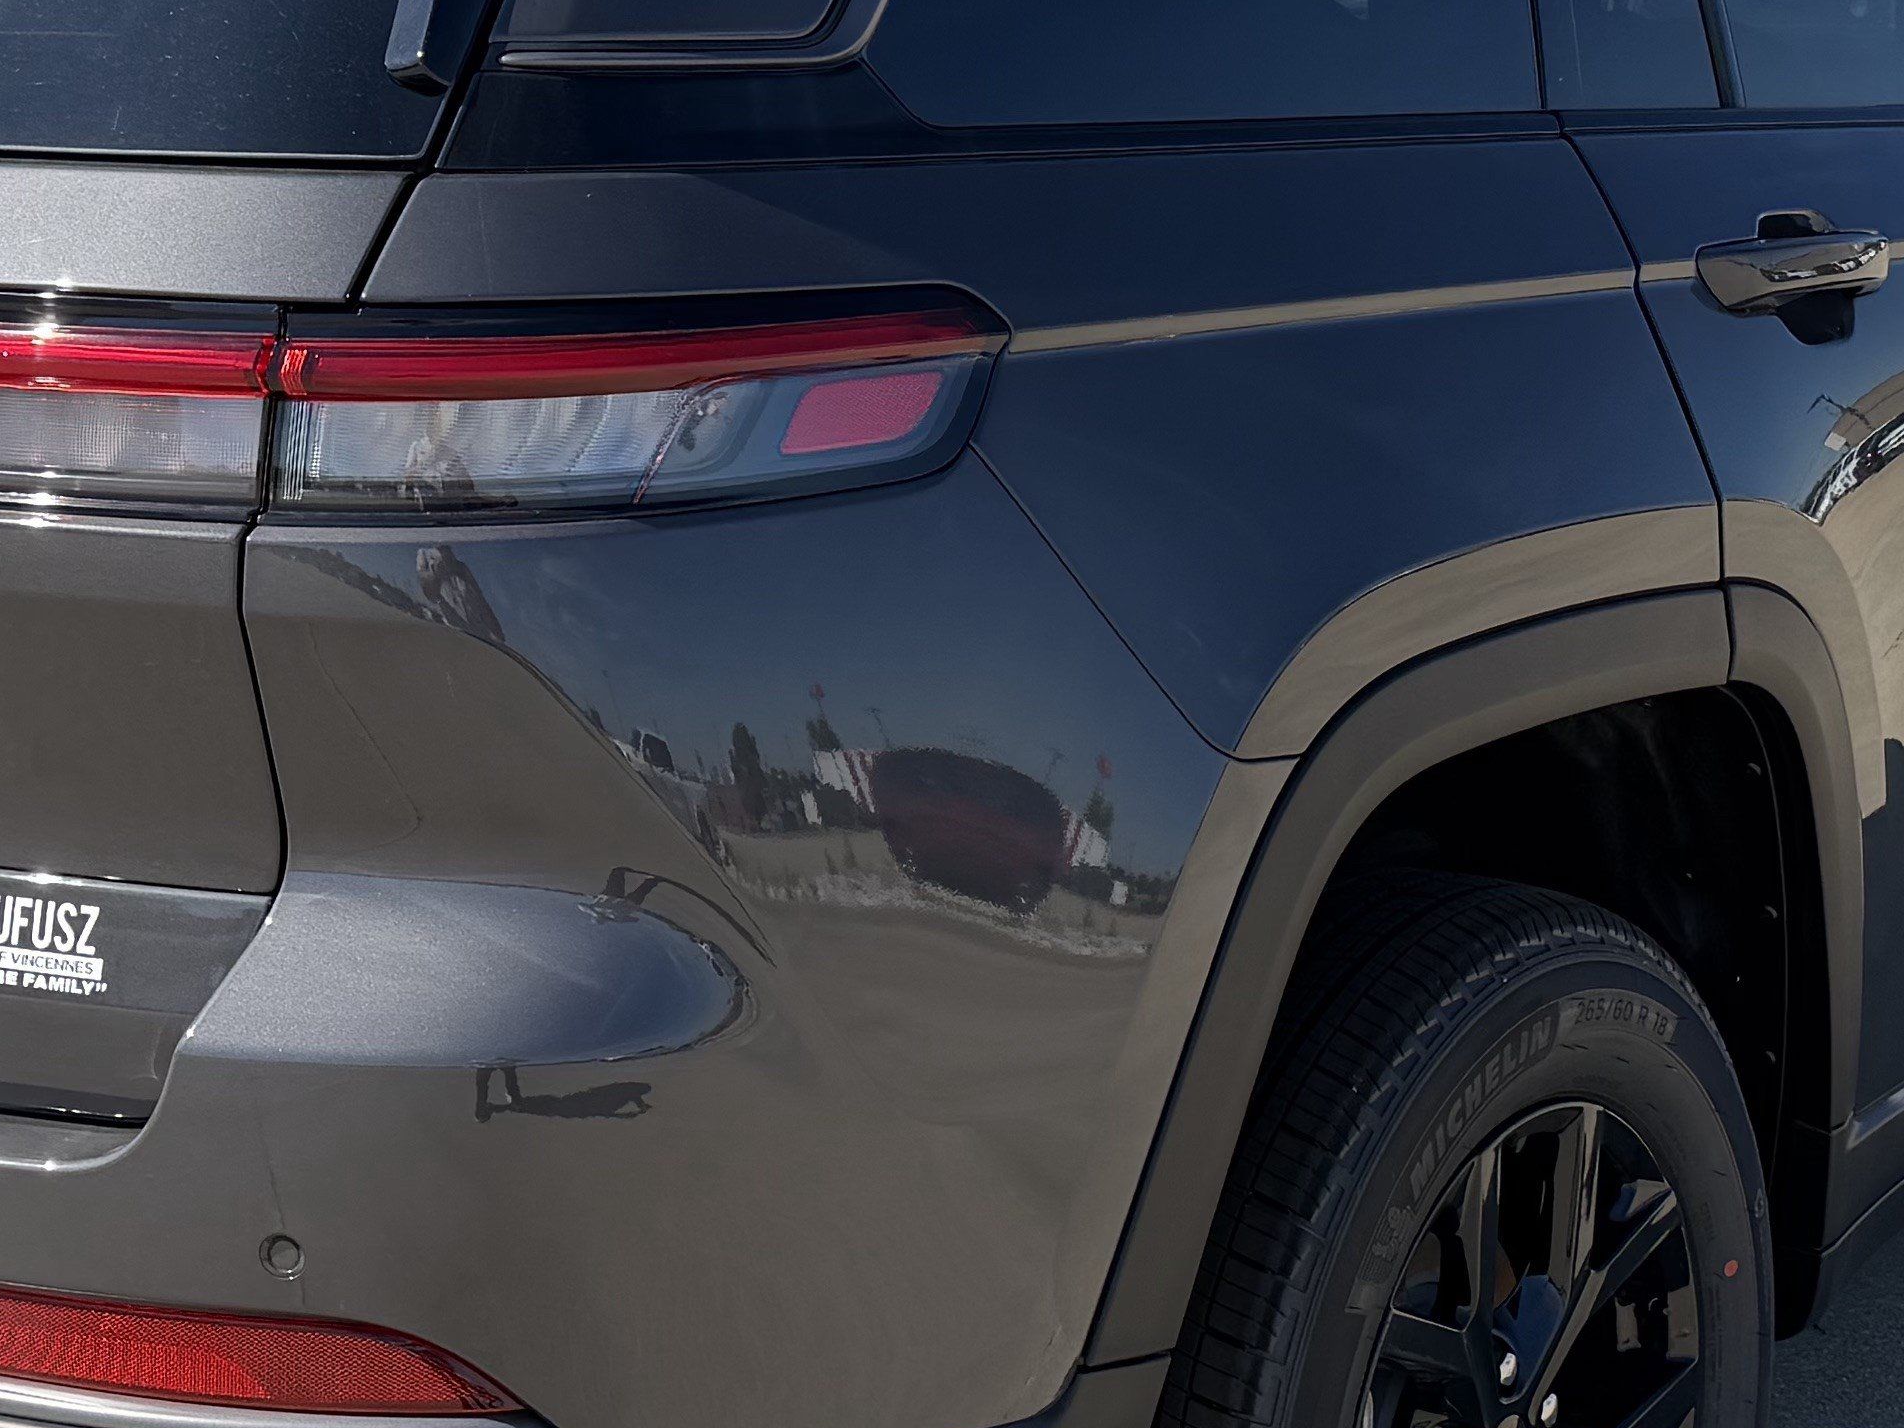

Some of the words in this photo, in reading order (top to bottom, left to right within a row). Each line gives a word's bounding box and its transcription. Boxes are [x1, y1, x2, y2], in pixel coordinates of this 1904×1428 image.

[11, 952, 94, 975] VINCENNES
[1576, 996, 1634, 1026] 265/60
[1637, 1005, 1649, 1025] R
[1653, 1009, 1669, 1036] 18
[1409, 1015, 1553, 1203] MICHELIN
